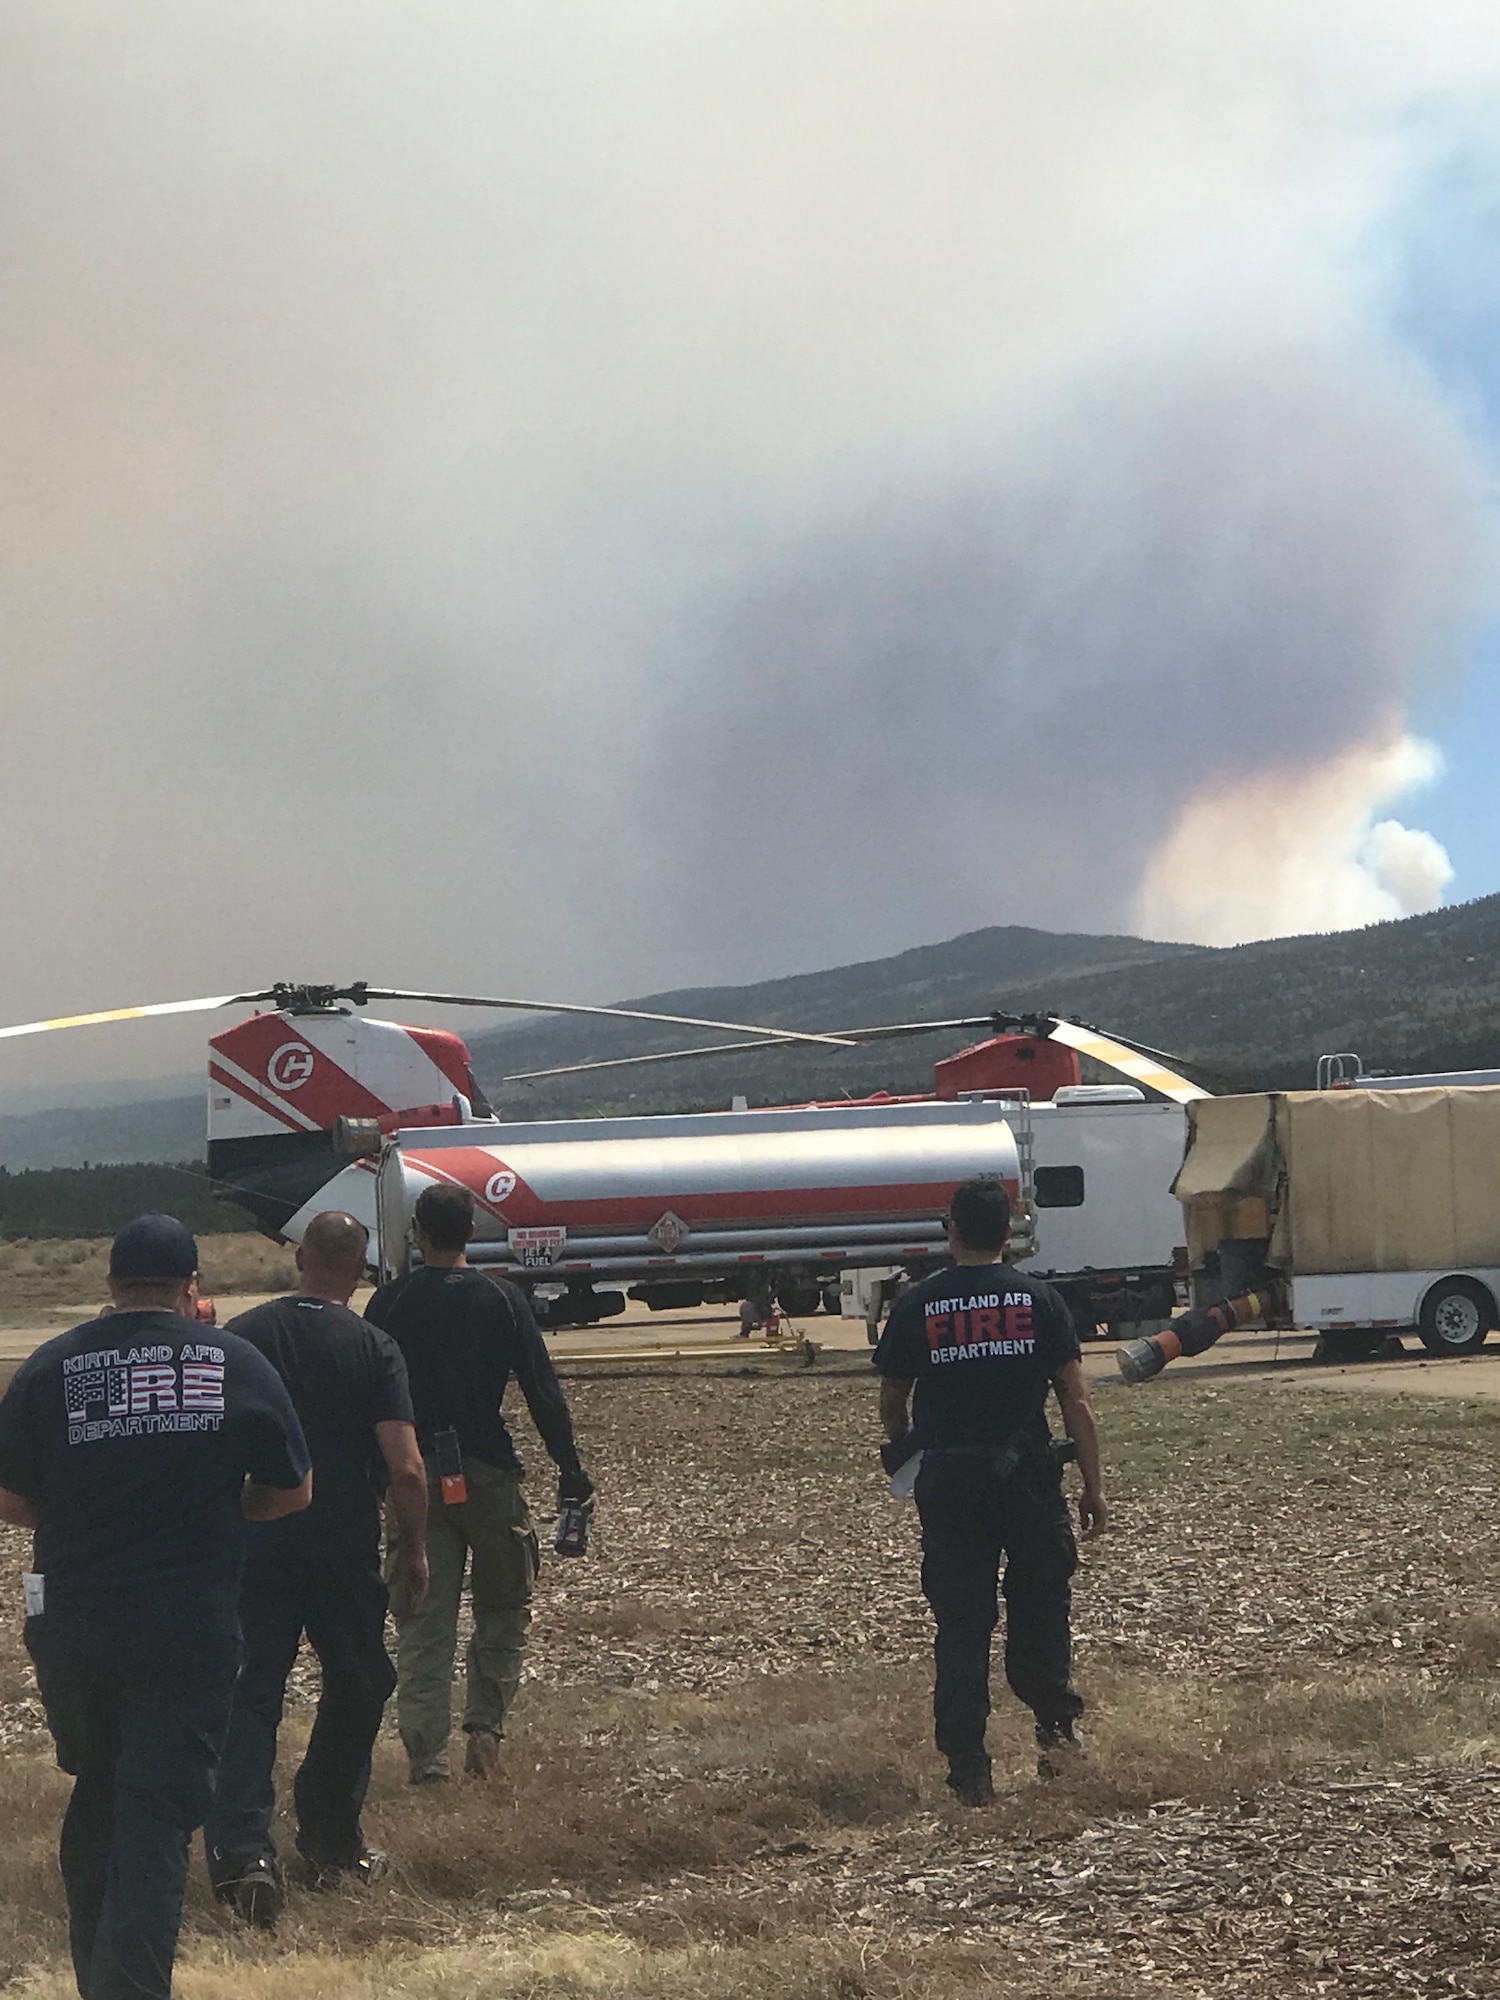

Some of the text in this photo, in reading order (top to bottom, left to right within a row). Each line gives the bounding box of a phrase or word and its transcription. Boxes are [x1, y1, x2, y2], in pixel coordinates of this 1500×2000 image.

[525, 1247, 552, 1257] JET A
[525, 1256, 550, 1266] FUEL
[924, 1292, 1033, 1317] KIRTLAND AFB
[925, 1306, 1035, 1350] FIRE
[63, 1344, 225, 1375] KIRTLAND AFB
[930, 1339, 1036, 1365] DEPARTMENT
[64, 1363, 225, 1424] FIRE
[68, 1413, 224, 1445] DEPARTMENT
